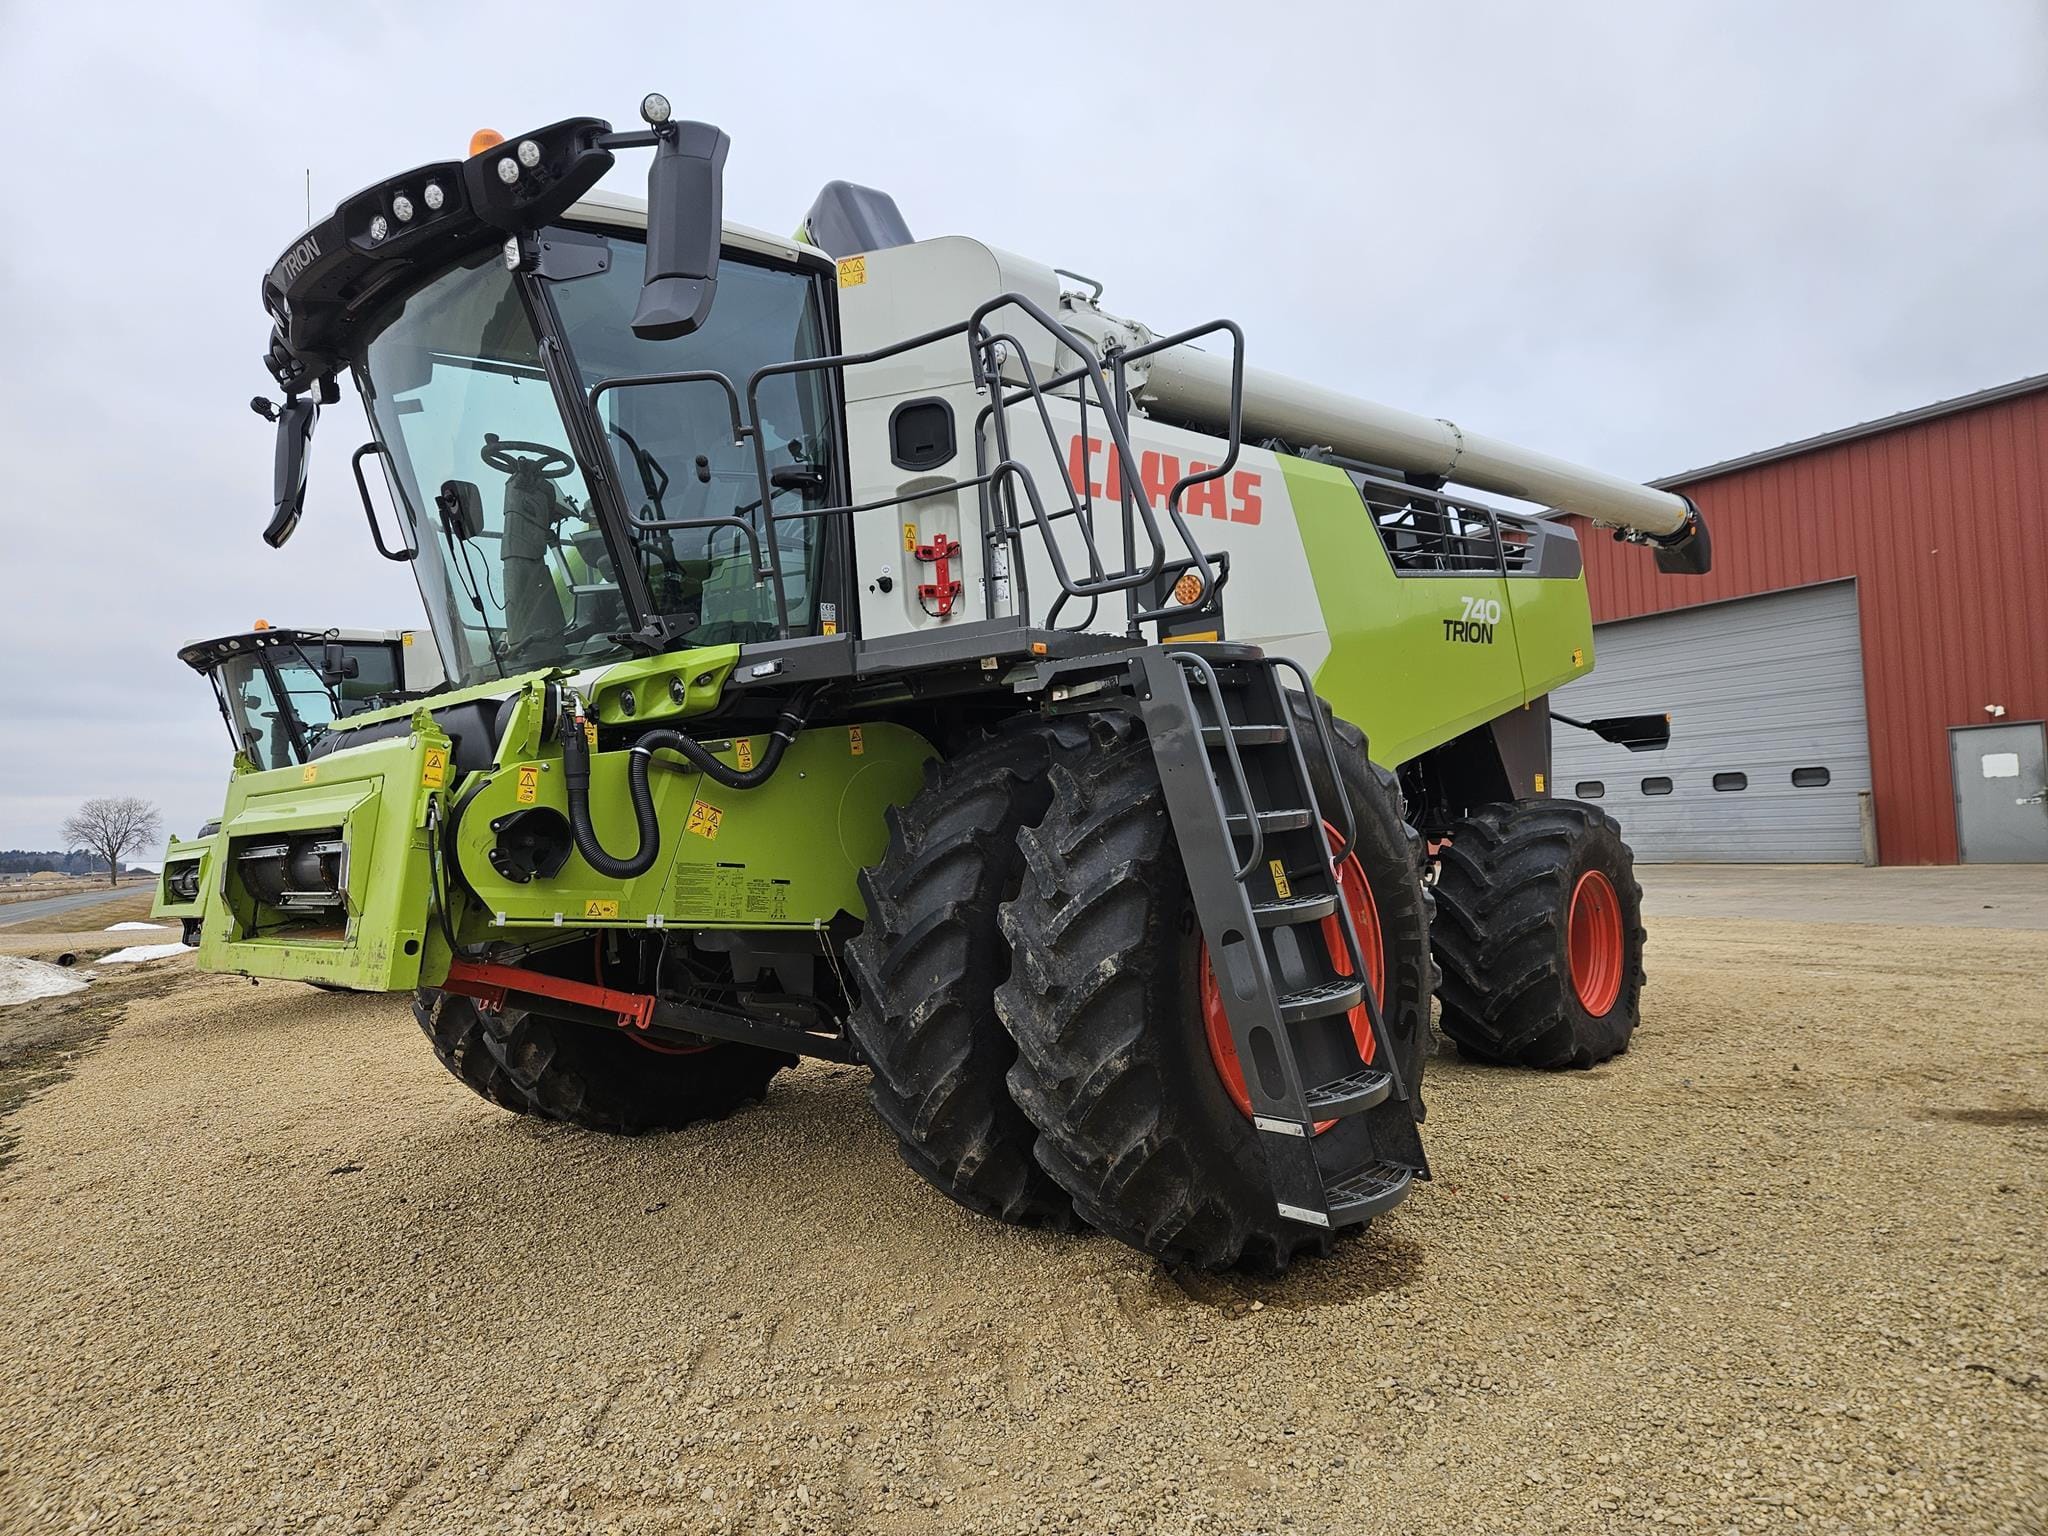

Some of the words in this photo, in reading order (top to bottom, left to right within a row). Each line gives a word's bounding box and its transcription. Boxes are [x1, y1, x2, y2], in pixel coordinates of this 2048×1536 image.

[281, 235, 321, 280] TRION
[1069, 435, 1261, 525] CLAAS
[1461, 596, 1500, 624] 740
[1443, 620, 1493, 644] TRION
